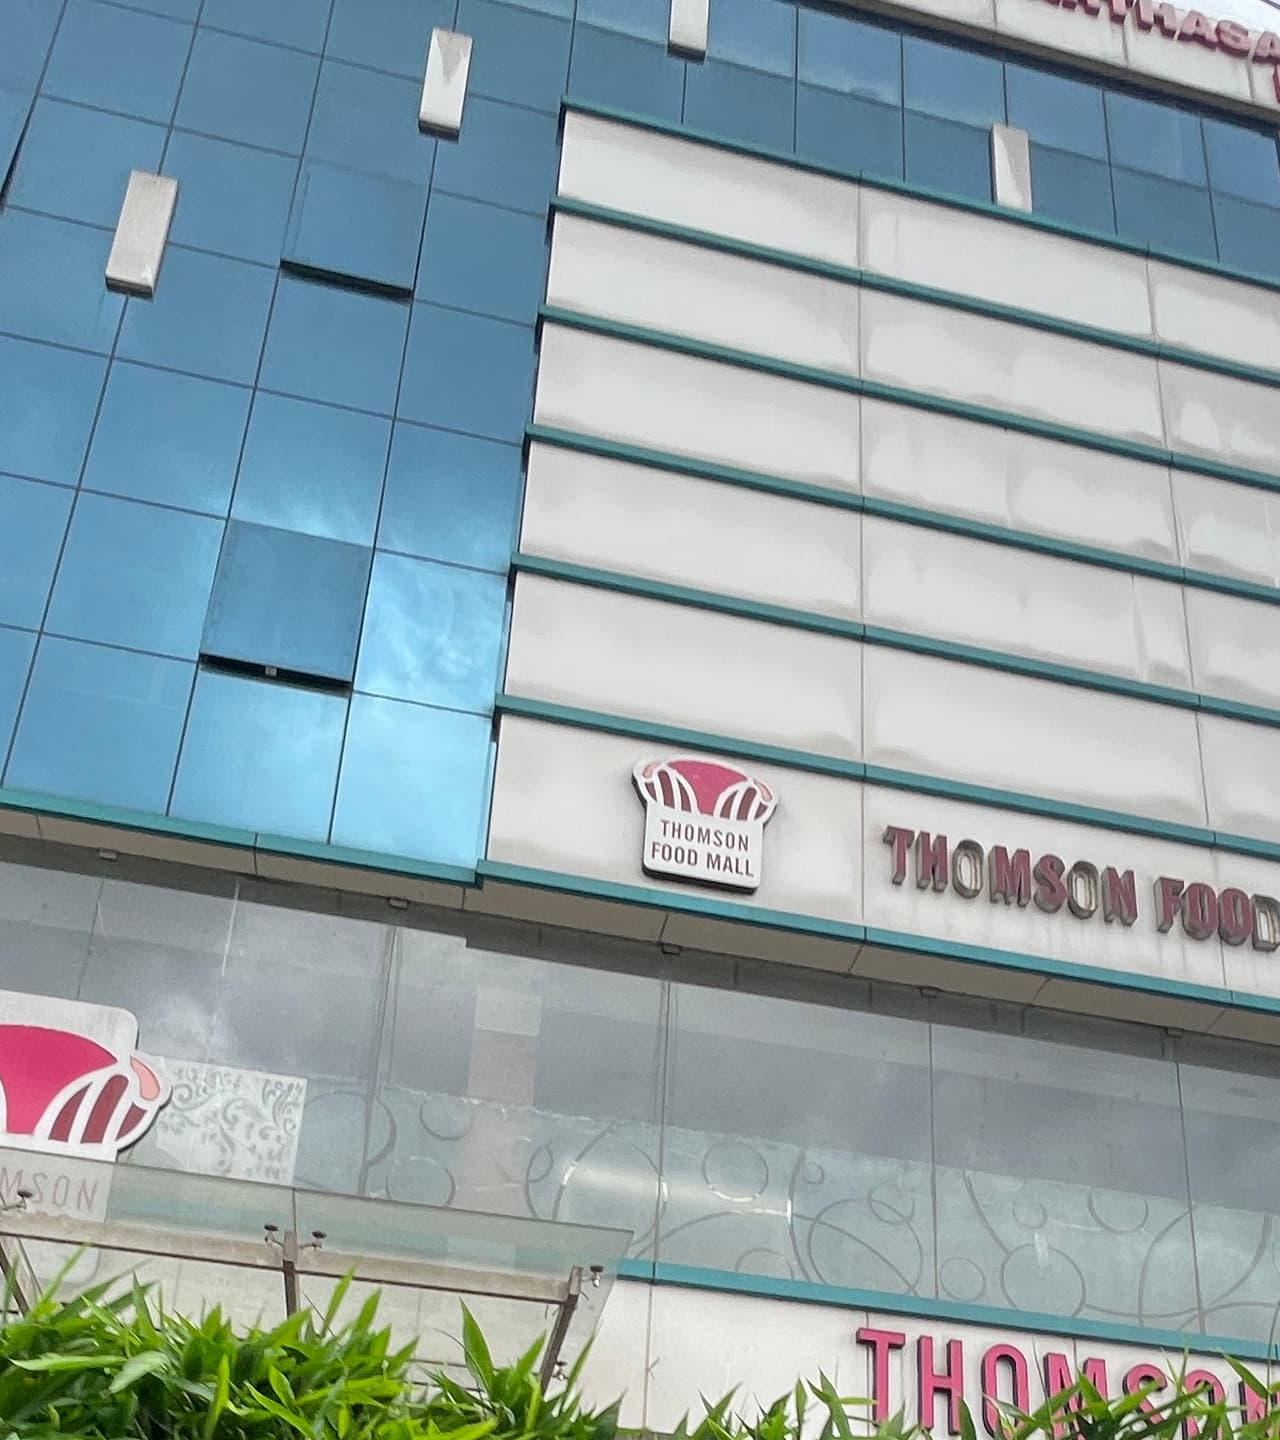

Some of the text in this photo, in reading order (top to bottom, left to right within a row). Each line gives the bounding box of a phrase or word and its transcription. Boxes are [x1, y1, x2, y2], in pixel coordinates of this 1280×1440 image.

[660, 819, 749, 852] THOMSON
[651, 841, 754, 877] FOOD MALL
[882, 825, 1138, 926] THOMSON
